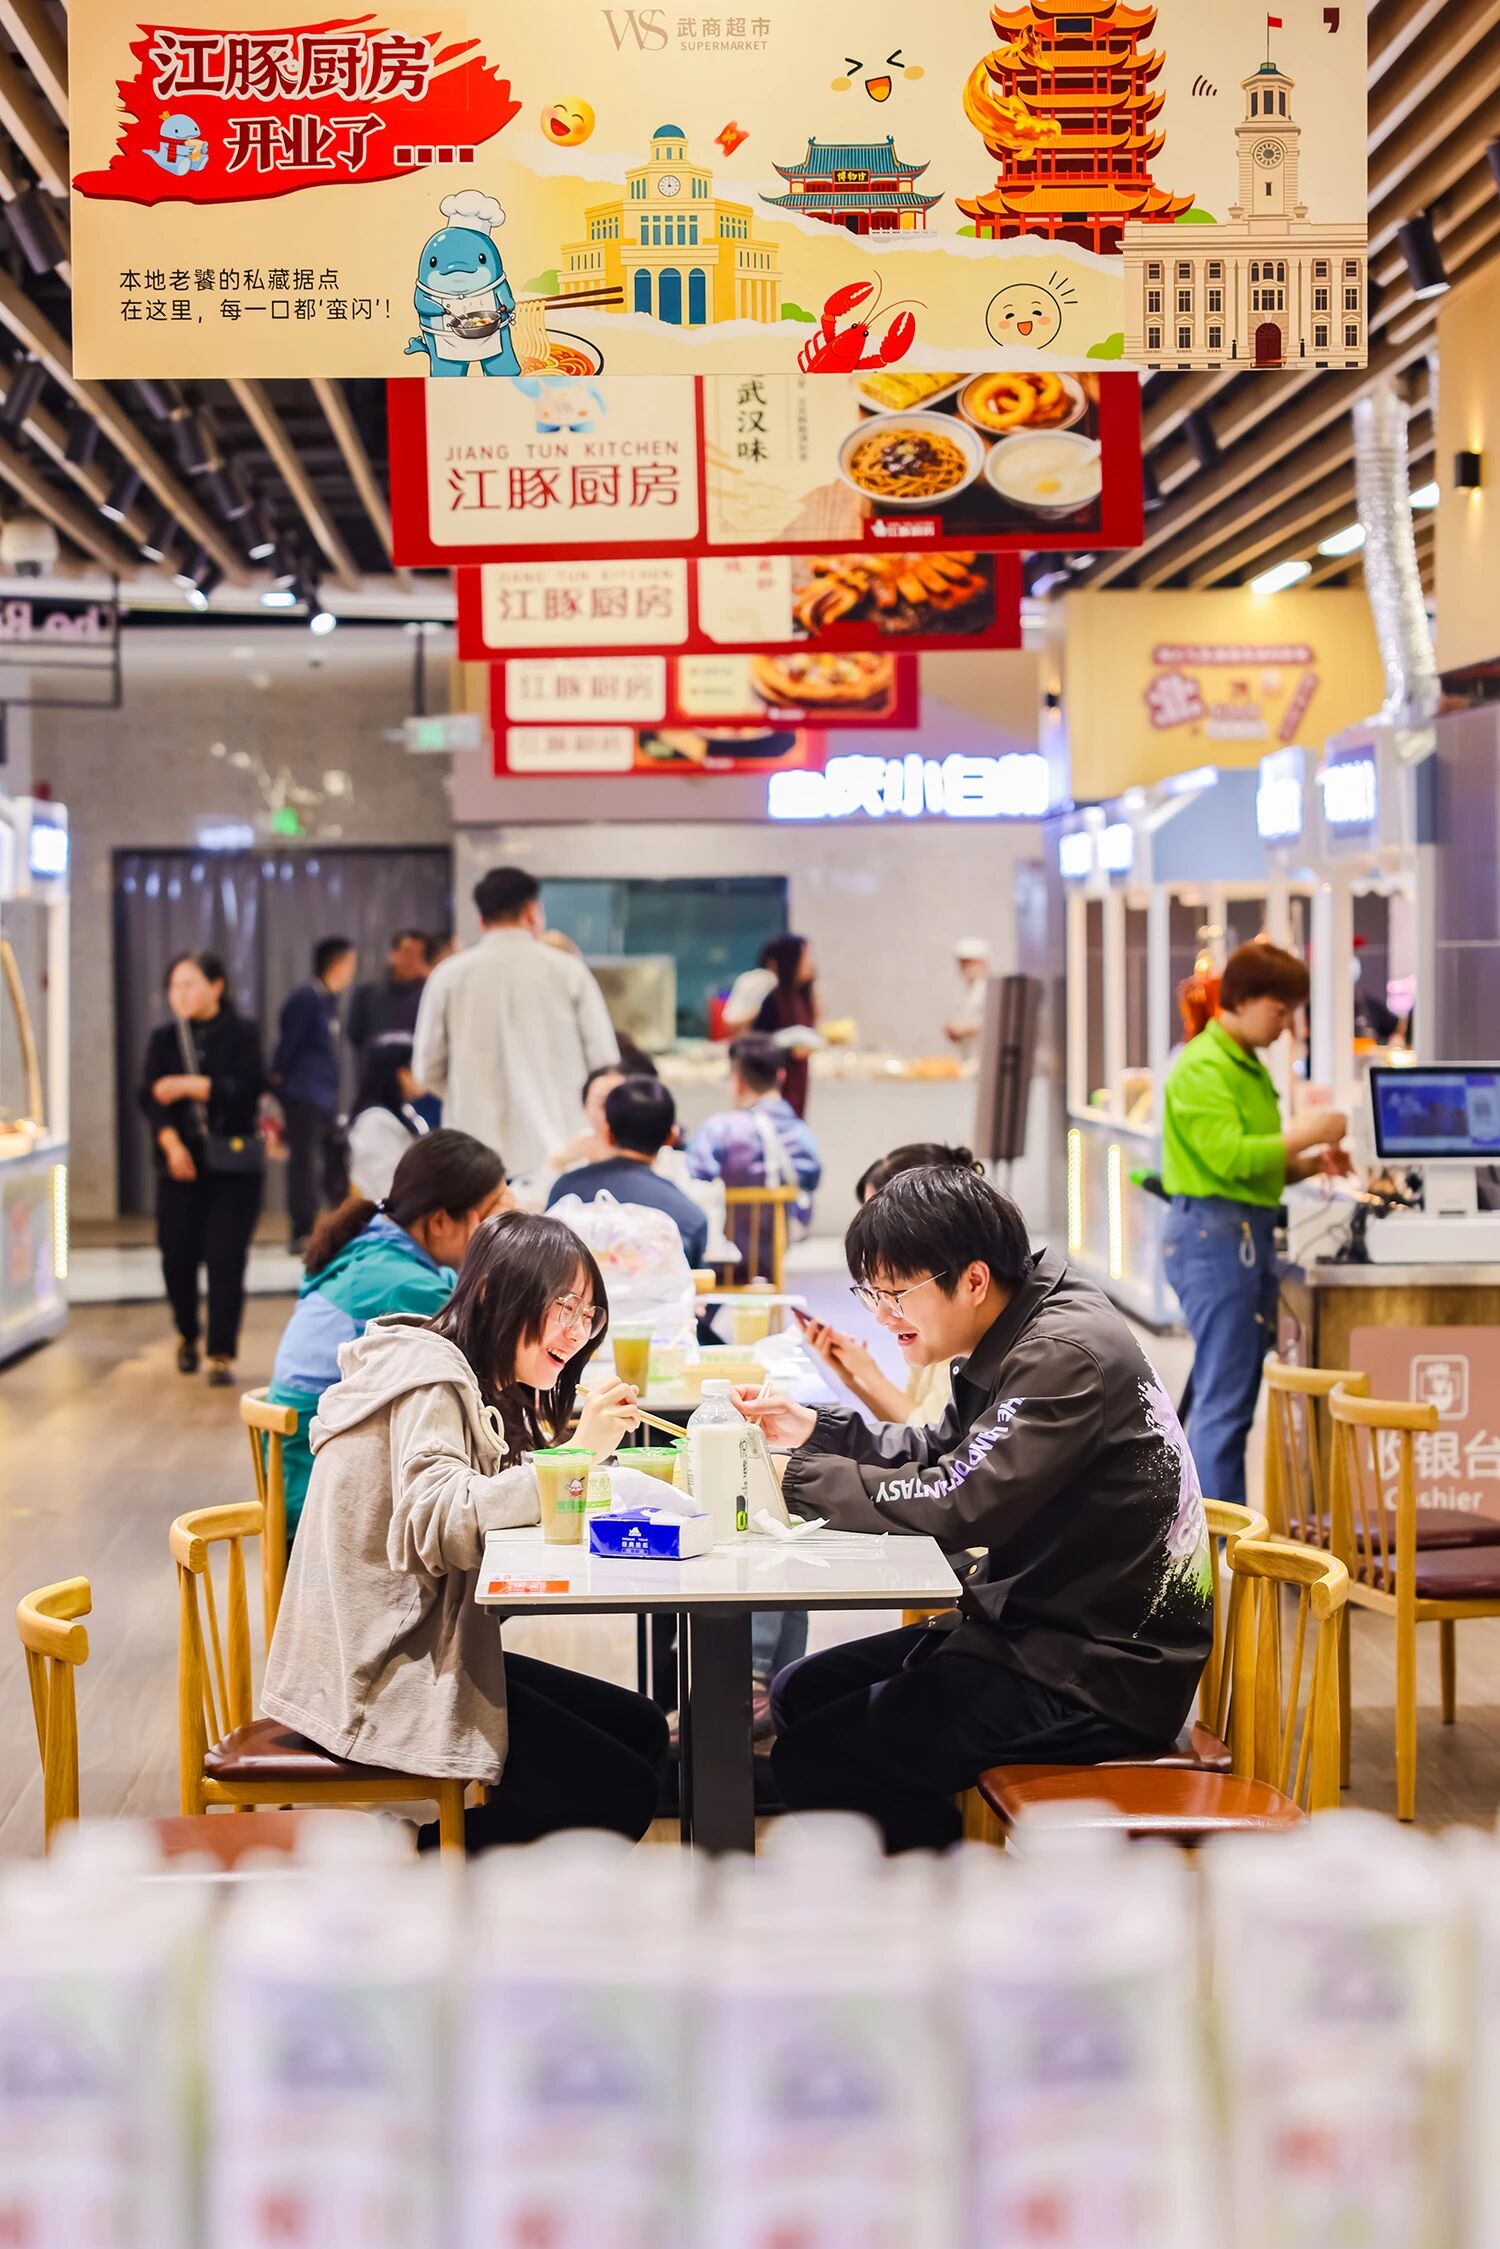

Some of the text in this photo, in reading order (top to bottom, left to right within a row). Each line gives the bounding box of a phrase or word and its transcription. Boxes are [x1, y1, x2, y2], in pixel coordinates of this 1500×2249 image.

[601, 9, 669, 51] WS
[677, 17, 771, 38] 武商超市
[681, 41, 768, 51] SUPERMARKET
[150, 30, 433, 102] 江豚厨房
[119, 268, 340, 291] 本地老饕的私藏据点
[446, 440, 679, 462] JIANG TUN KITCHEN
[448, 462, 681, 512] 江豚厨房
[500, 585, 673, 621] 江豚厨房
[969, 1426, 1009, 1465] LAND
[1384, 1485, 1483, 1512] Cshier
